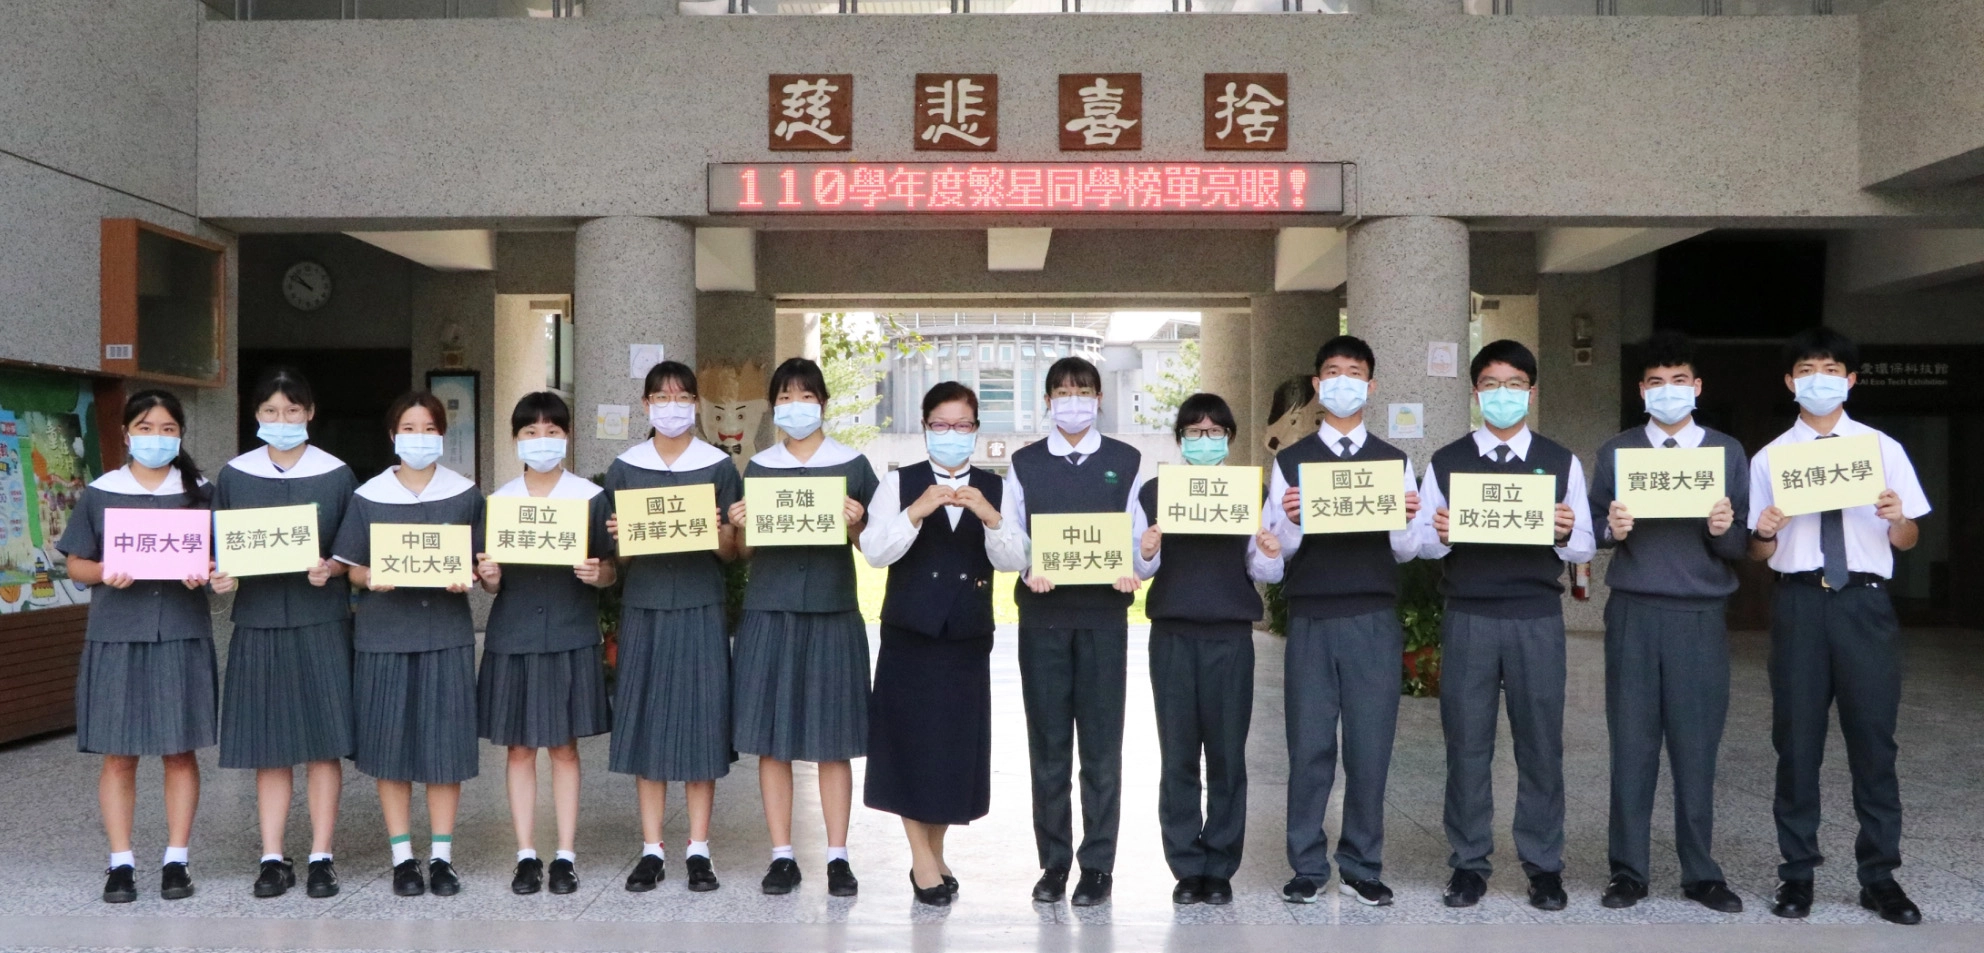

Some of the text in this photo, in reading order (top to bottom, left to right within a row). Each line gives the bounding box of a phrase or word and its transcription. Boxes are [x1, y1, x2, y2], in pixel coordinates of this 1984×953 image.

[1857, 362, 1949, 375] 愛環保科技館
[1888, 378, 1906, 386] Tech
[1331, 468, 1375, 490] 國立
[1627, 470, 1715, 492] 實踐大學
[1781, 459, 1873, 491] 銘傳大學
[1189, 477, 1229, 497] 國立
[1481, 482, 1523, 503] 國立
[646, 494, 687, 516] 國立
[775, 488, 815, 509] 高雄
[1311, 494, 1398, 518] 交通大學
[518, 505, 558, 525] 國立
[756, 513, 835, 534] 醫學大學
[1168, 502, 1250, 524] 中山大學
[1458, 508, 1544, 530] 政治大學
[225, 525, 311, 551] 慈濟大學
[401, 531, 441, 550] 中國
[497, 529, 577, 551] 東華大學
[627, 517, 708, 542] 清華大學
[1062, 525, 1101, 546] 中山
[114, 532, 203, 554] 中原大學
[381, 554, 462, 575] 文化大學
[1042, 550, 1123, 572] 醫學大學
